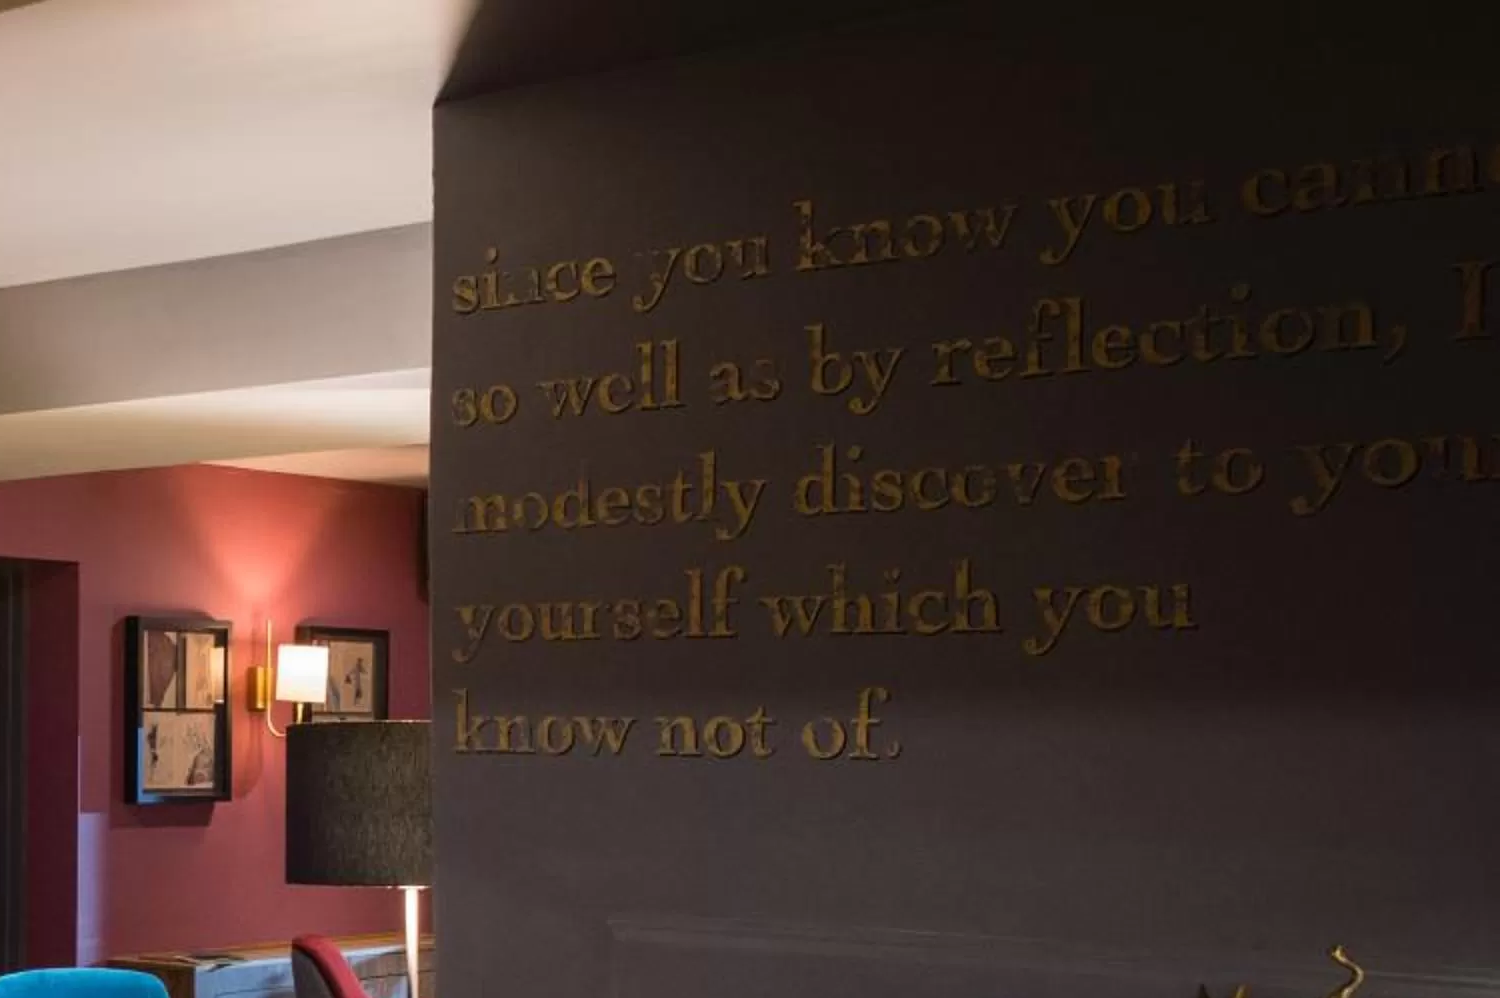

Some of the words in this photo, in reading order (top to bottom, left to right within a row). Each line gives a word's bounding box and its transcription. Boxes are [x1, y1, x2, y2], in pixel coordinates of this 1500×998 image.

[451, 248, 616, 313] since
[633, 231, 769, 311] you
[794, 201, 1017, 272] know
[1040, 176, 1215, 263] you
[1241, 143, 1500, 218] cann
[451, 384, 518, 427] so
[536, 339, 686, 416] well
[709, 357, 782, 405] as
[806, 325, 904, 415] by
[930, 284, 1408, 386] reflection,
[1451, 260, 1493, 343] I
[452, 450, 768, 541] modestly
[794, 443, 1135, 517] discover
[1175, 439, 1265, 497] to
[1291, 433, 1500, 517] you
[452, 567, 747, 663] yourself
[759, 560, 1004, 640] which
[1025, 578, 1196, 655] you
[454, 691, 638, 758] know
[654, 705, 774, 758] not
[802, 687, 901, 761] of.
